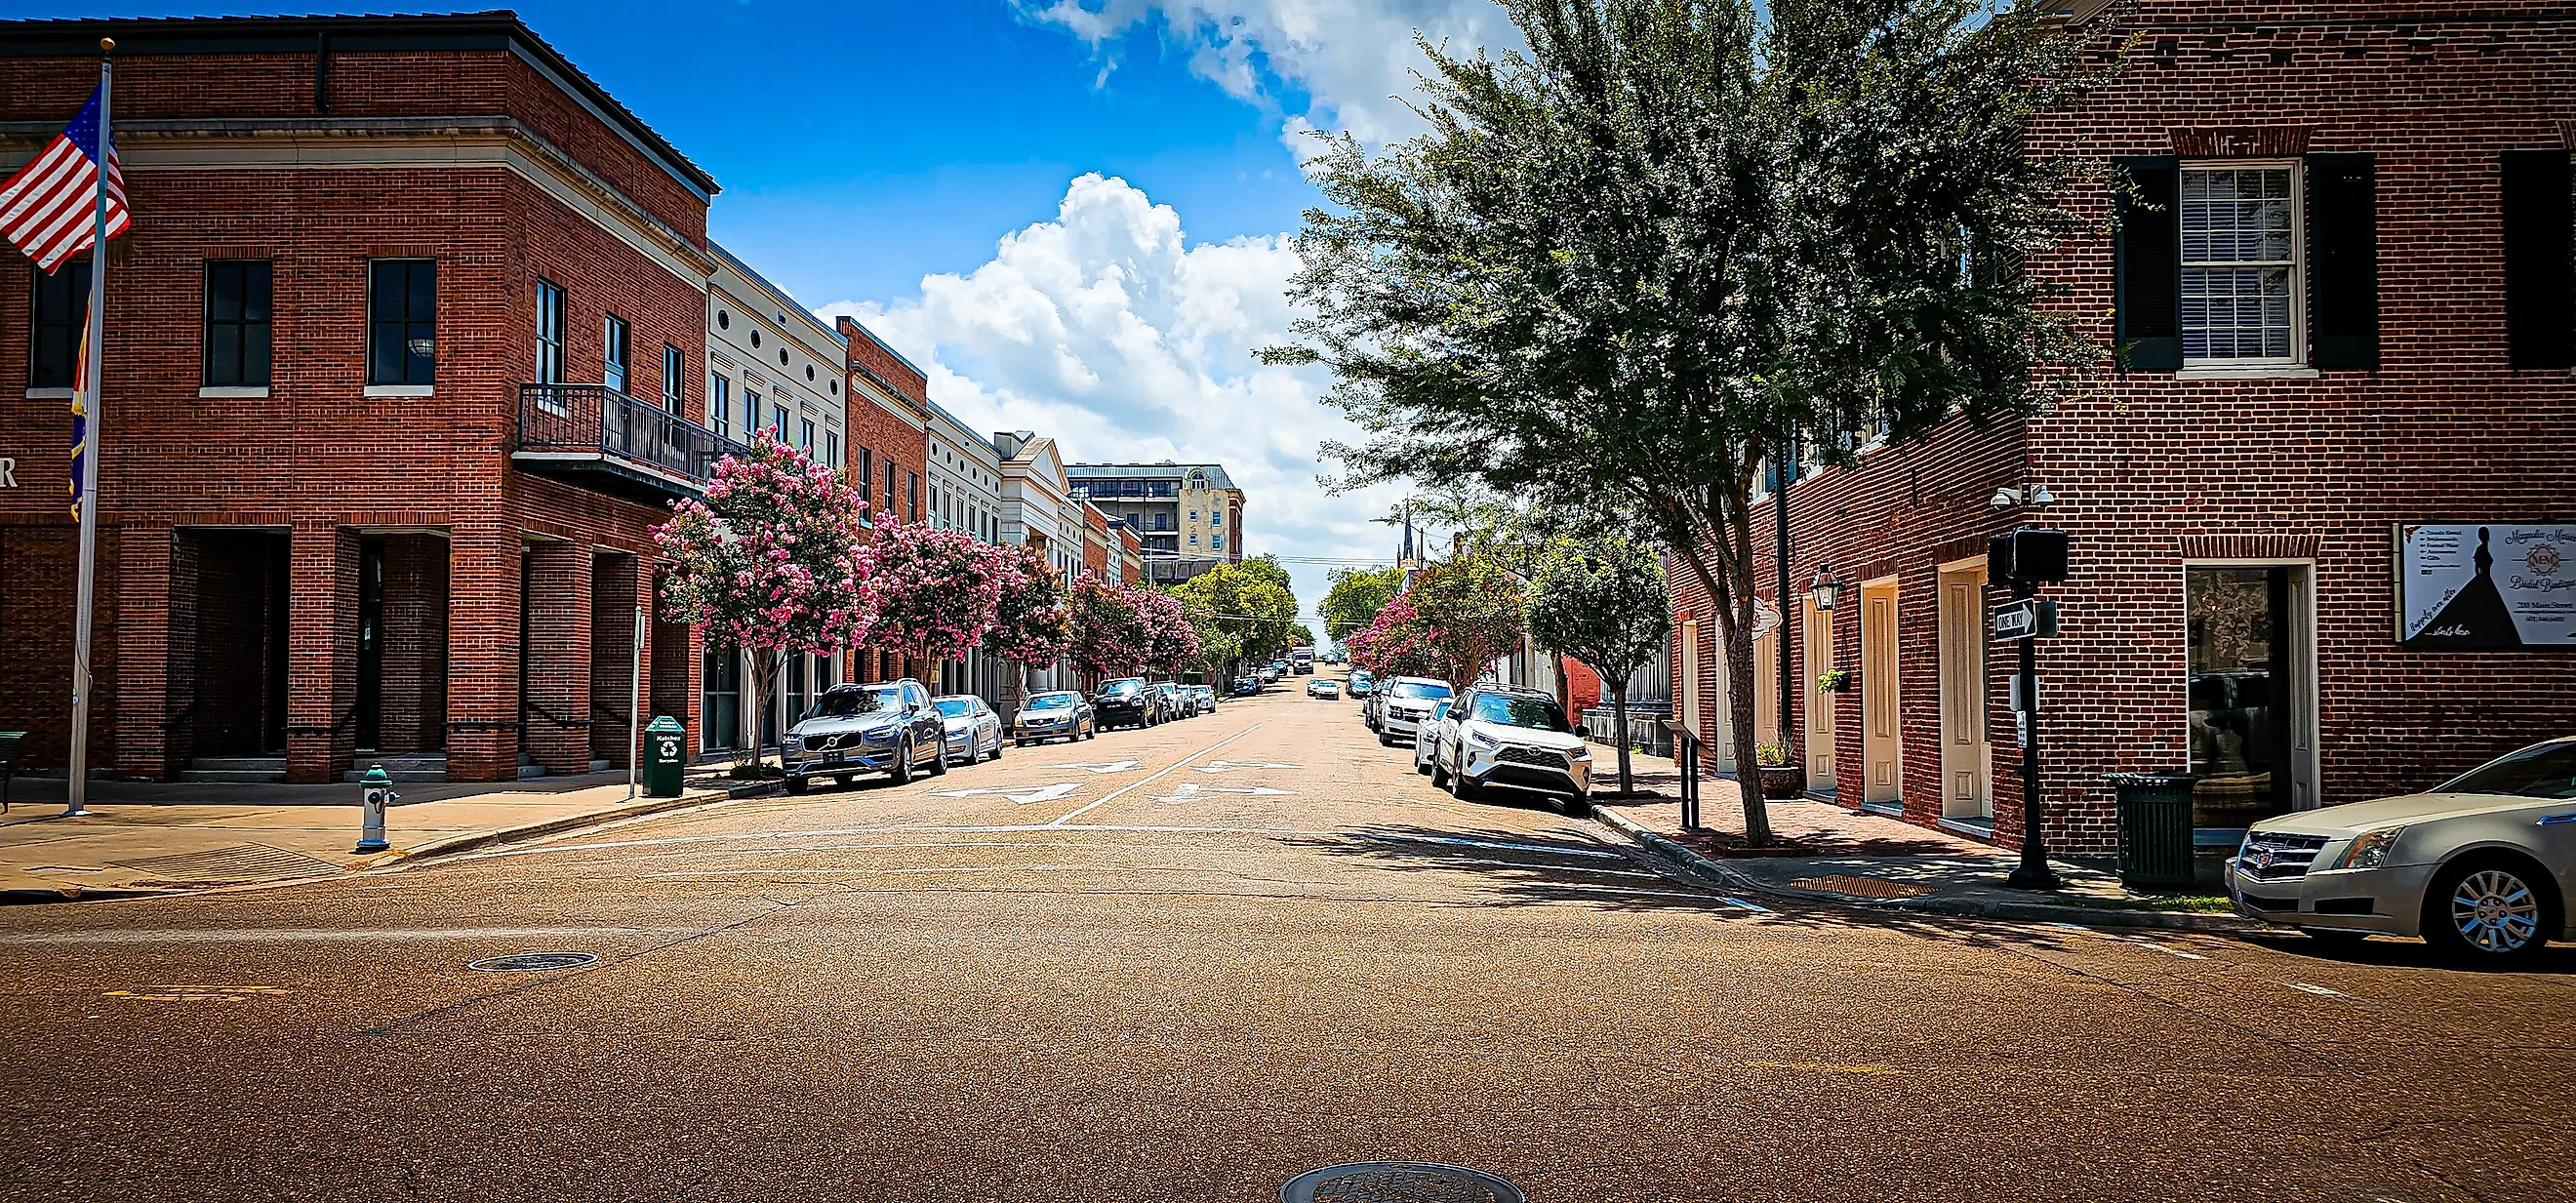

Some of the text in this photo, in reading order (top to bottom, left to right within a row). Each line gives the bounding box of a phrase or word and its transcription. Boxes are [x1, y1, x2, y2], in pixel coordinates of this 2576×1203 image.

[2510, 575, 2539, 589] Bridal
[1998, 613, 2024, 629] ONE WAY
[2409, 609, 2433, 632] Happily
